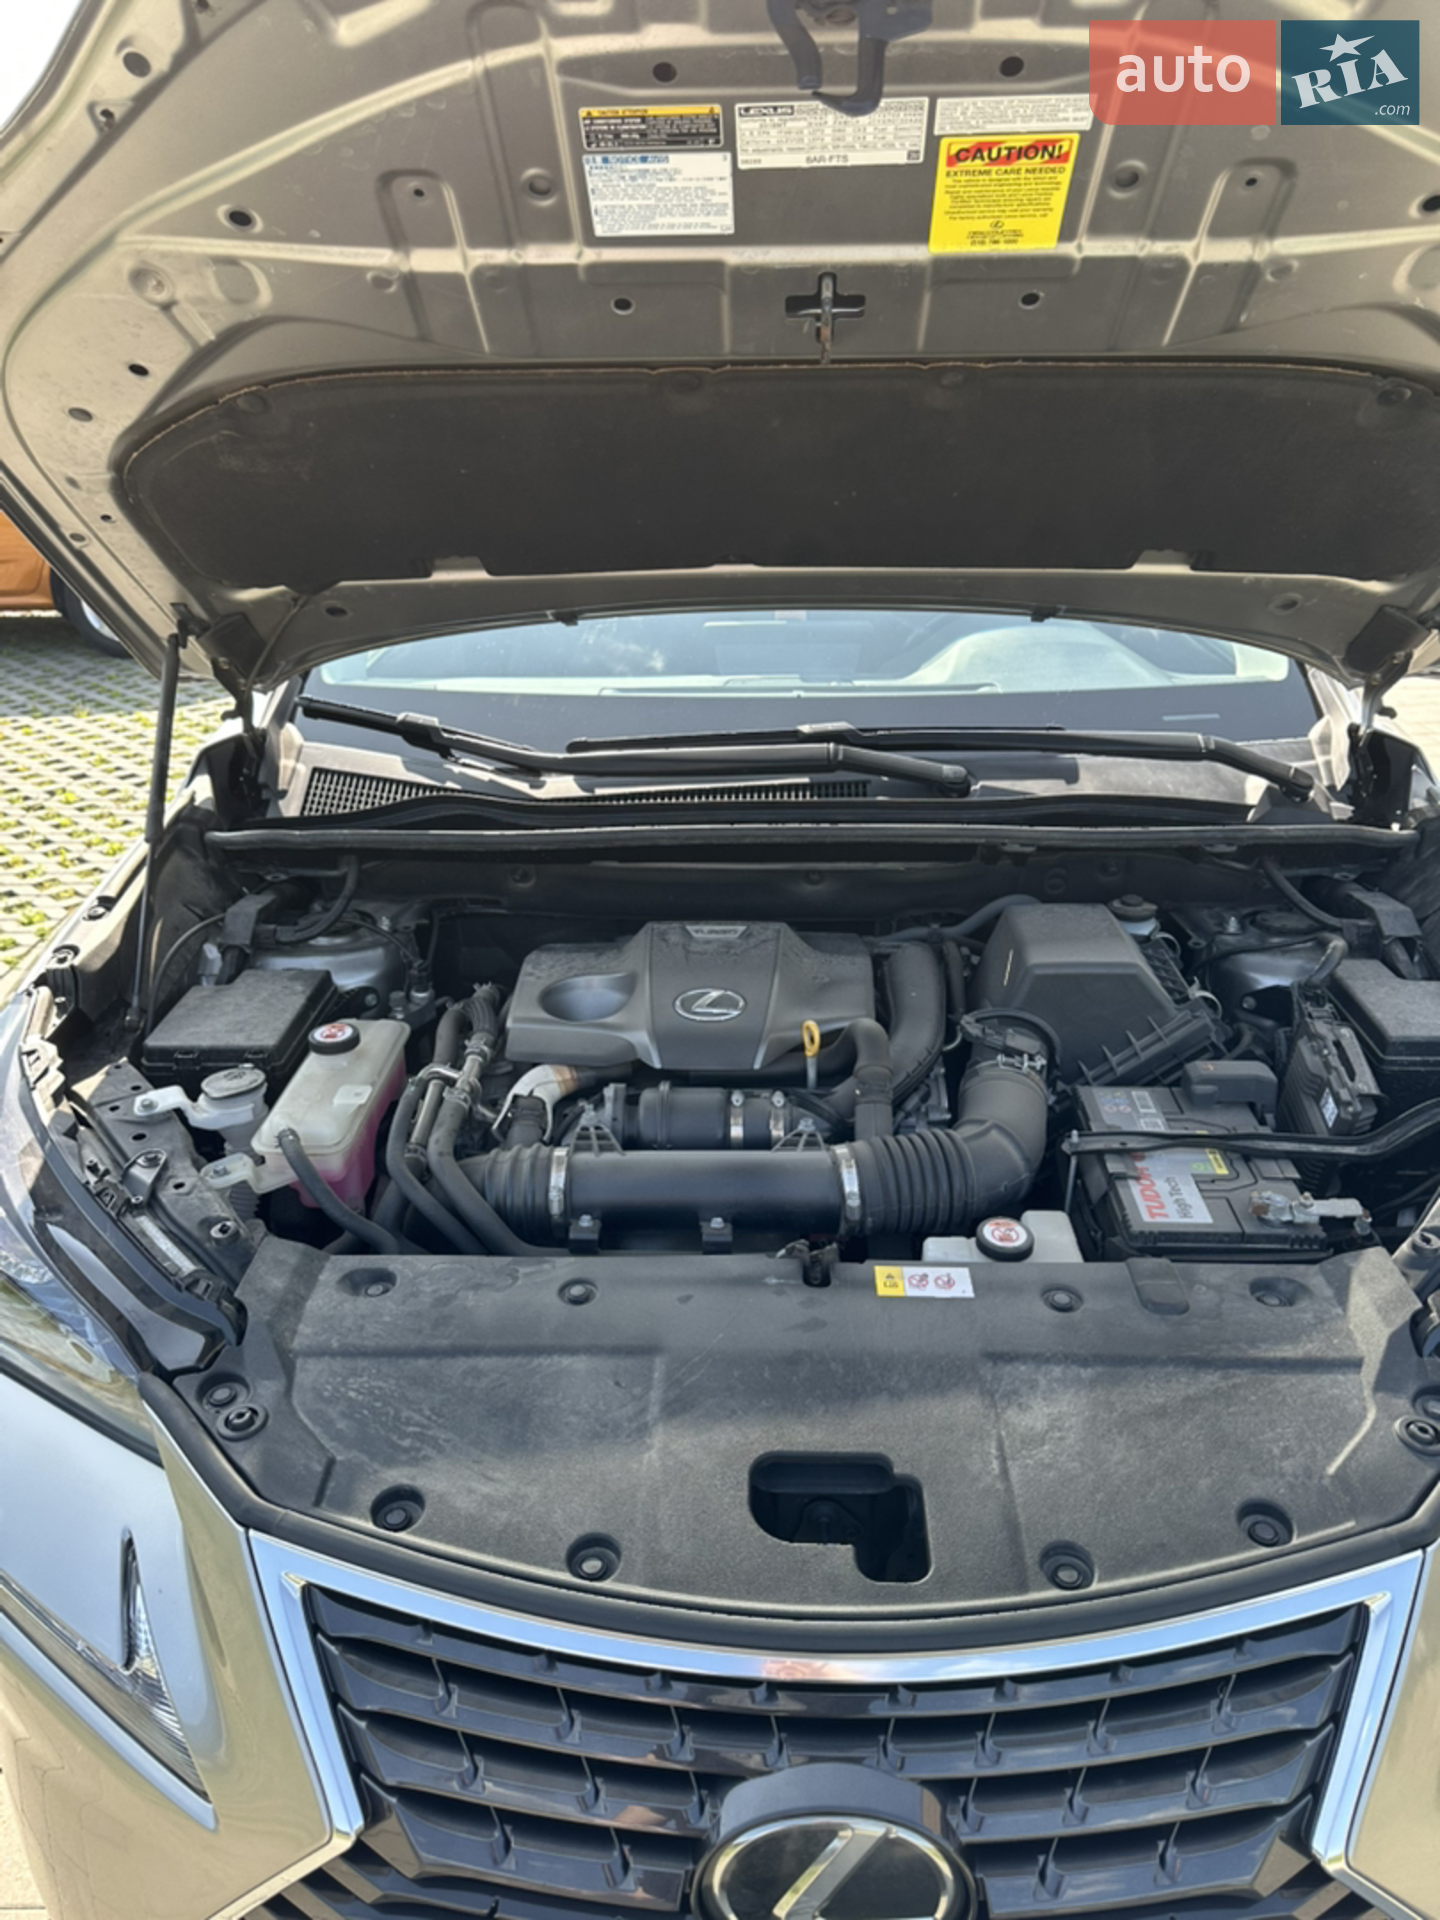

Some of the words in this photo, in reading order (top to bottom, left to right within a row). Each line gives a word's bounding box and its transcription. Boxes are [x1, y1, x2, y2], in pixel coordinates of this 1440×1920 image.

[955, 144, 1064, 164] CAUTION!
[945, 168, 993, 179] EXTREME
[995, 167, 1023, 176] CARE
[1024, 165, 1066, 175] NEEDED
[1165, 1176, 1183, 1198] Tech
[1174, 1197, 1194, 1219] High
